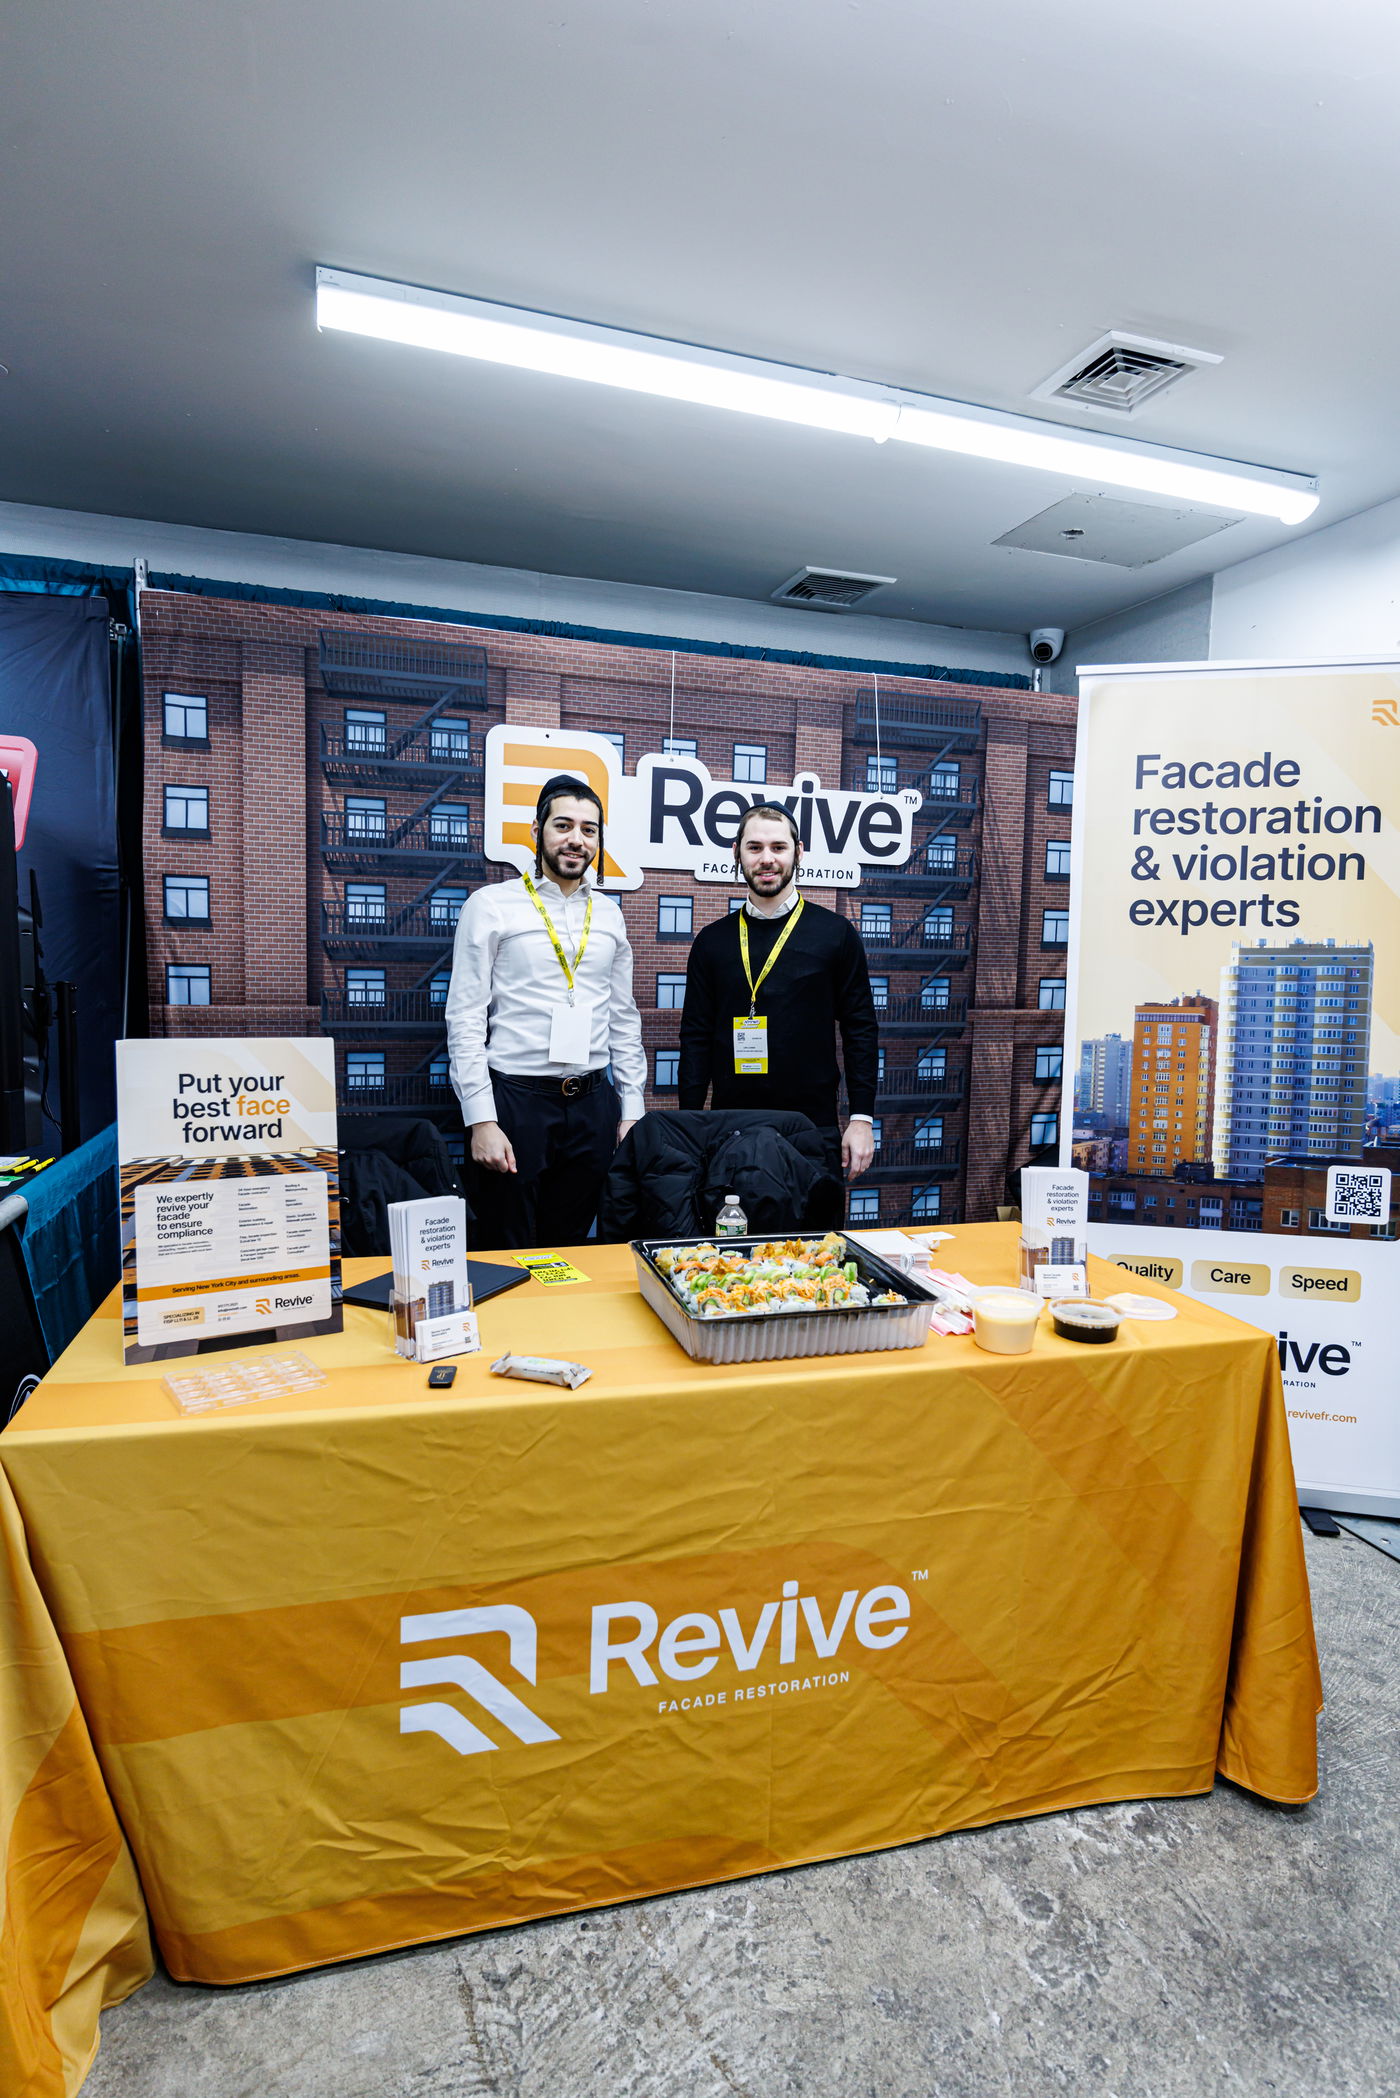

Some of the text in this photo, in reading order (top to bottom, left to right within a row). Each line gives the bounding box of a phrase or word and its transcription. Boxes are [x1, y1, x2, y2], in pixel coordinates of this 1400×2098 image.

[1135, 751, 1301, 790] Facade
[1133, 796, 1382, 835] restoration
[1130, 843, 1365, 881] & violation
[1129, 894, 1300, 935] experts
[179, 1073, 284, 1097] Put your
[173, 1095, 290, 1119] best face
[182, 1118, 282, 1143] forward
[157, 1192, 214, 1204] We expertly
[157, 1202, 209, 1213] revive your
[157, 1212, 190, 1221] facade
[425, 1217, 450, 1225] Facade
[157, 1220, 202, 1231] to ensure
[420, 1225, 456, 1235] restoration
[157, 1228, 213, 1239] compliance
[427, 1234, 455, 1242] violation
[425, 1242, 451, 1252] experts
[432, 1258, 454, 1266] Revive
[1210, 1268, 1251, 1285] Care
[1291, 1274, 1348, 1292] Speed
[172, 1286, 195, 1294] Serving
[250, 1275, 283, 1284] surrounding
[275, 1296, 312, 1308] Revive
[1277, 1331, 1351, 1376] ive
[1283, 1380, 1316, 1388] RATION
[1288, 1410, 1357, 1423] revivefr.com
[589, 1580, 911, 1694] Revive
[658, 1671, 850, 1714] FACADE RESTORATION
